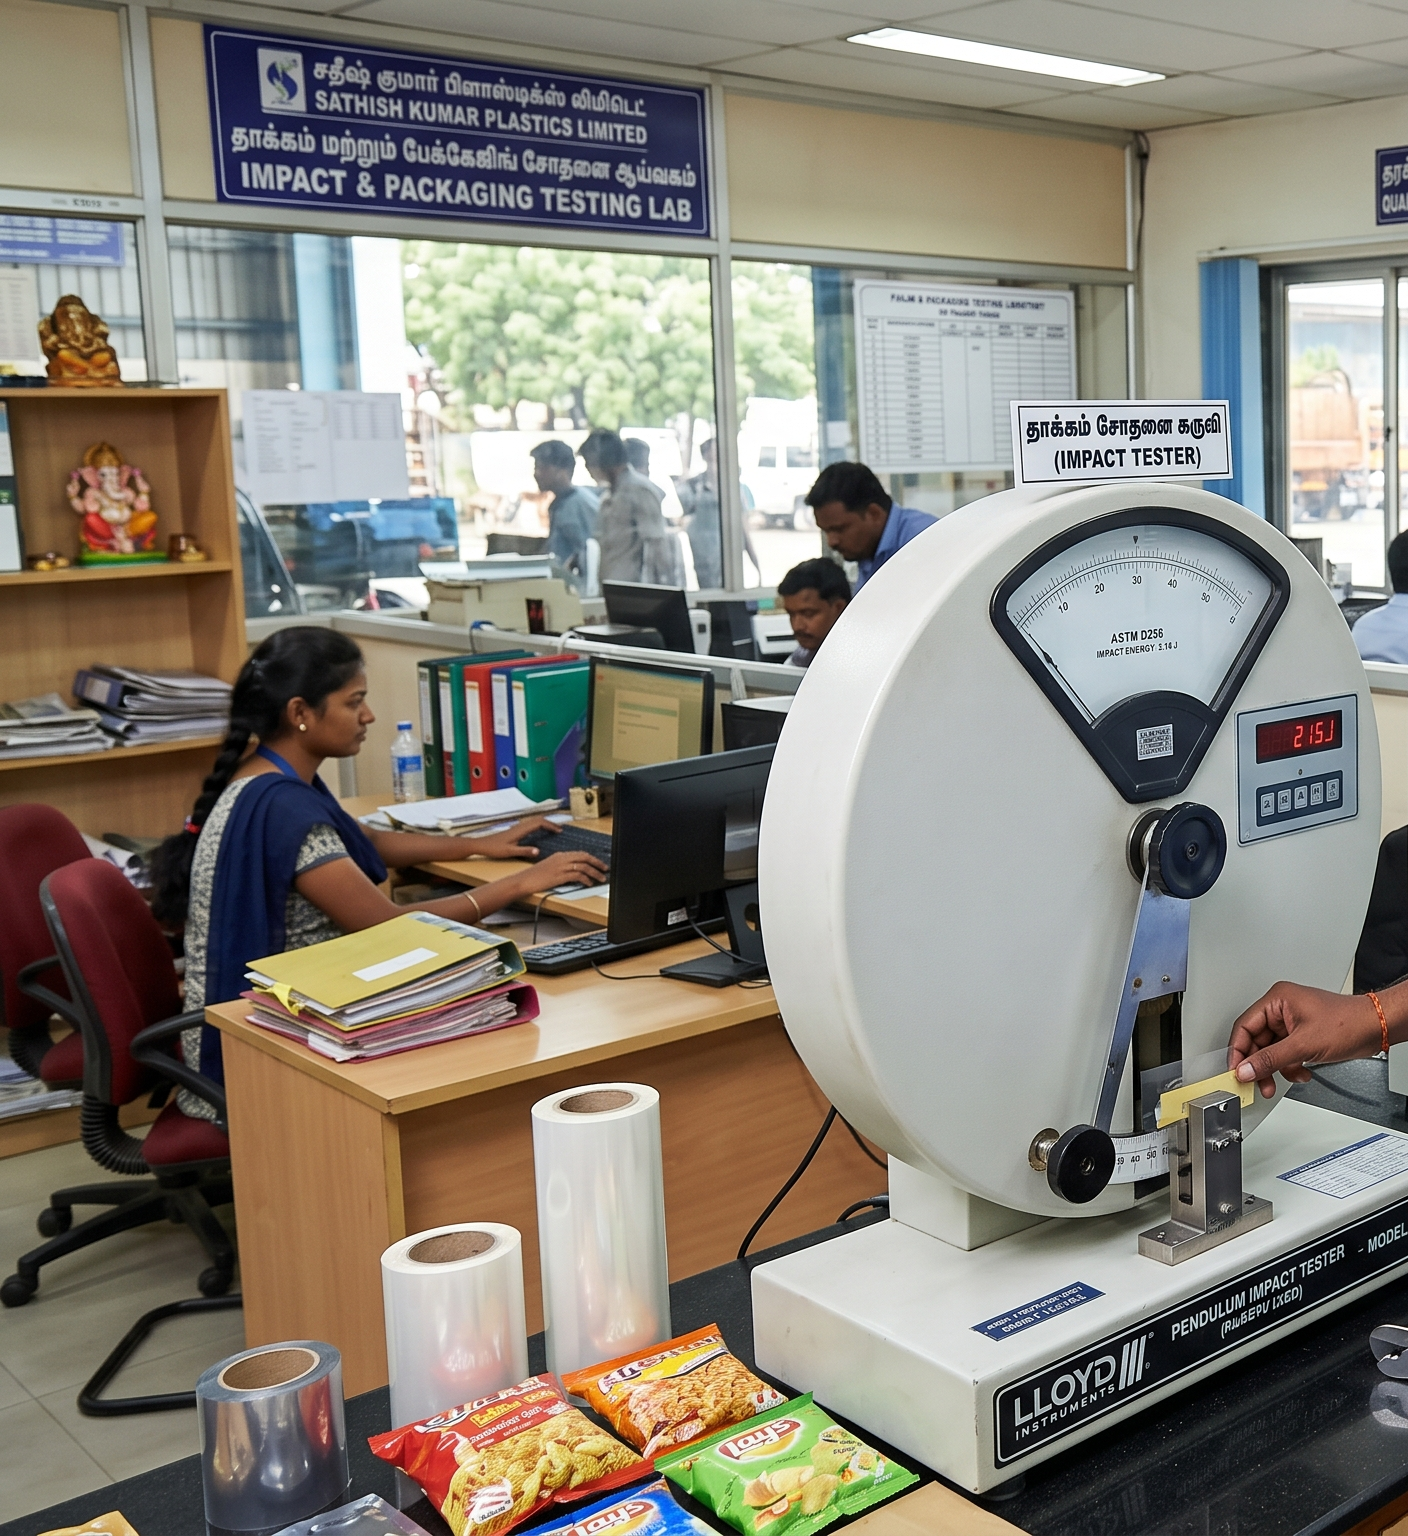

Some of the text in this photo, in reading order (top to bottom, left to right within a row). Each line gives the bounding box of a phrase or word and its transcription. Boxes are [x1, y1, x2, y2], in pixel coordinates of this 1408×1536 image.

[313, 56, 371, 90] சதீஷ்
[377, 68, 439, 93] குமார்
[445, 72, 566, 108] பிளாஸ்டிக்ஸ்
[315, 90, 647, 145] SATHISH KUMAR PLASTICS LIMITED
[231, 122, 696, 189] தாக்கம் மற்றும் பேக்கேஜிங் சோதனை ஆய்வகம்
[241, 162, 692, 222] IMPACT & PACKAGING TESTING LAB
[1026, 412, 1221, 444] தாக்கம் சோதனை கருவி
[1054, 446, 1201, 474] (IMPACT TESTER)
[1094, 583, 1105, 595] 20
[1132, 576, 1142, 585] 30
[1167, 579, 1178, 589] 40
[1058, 601, 1069, 614] 10
[1111, 628, 1164, 644] ASTM D256
[1097, 647, 1124, 658] IMPACT
[1171, 1291, 1246, 1341] PENDULUM
[1249, 1267, 1296, 1304] IMPACT
[1299, 1244, 1345, 1278] TESTER
[1368, 1223, 1408, 1253] MODEL
[1014, 1355, 1116, 1427] LLOYD
[1015, 1383, 1115, 1441] INSTRUMENTS
